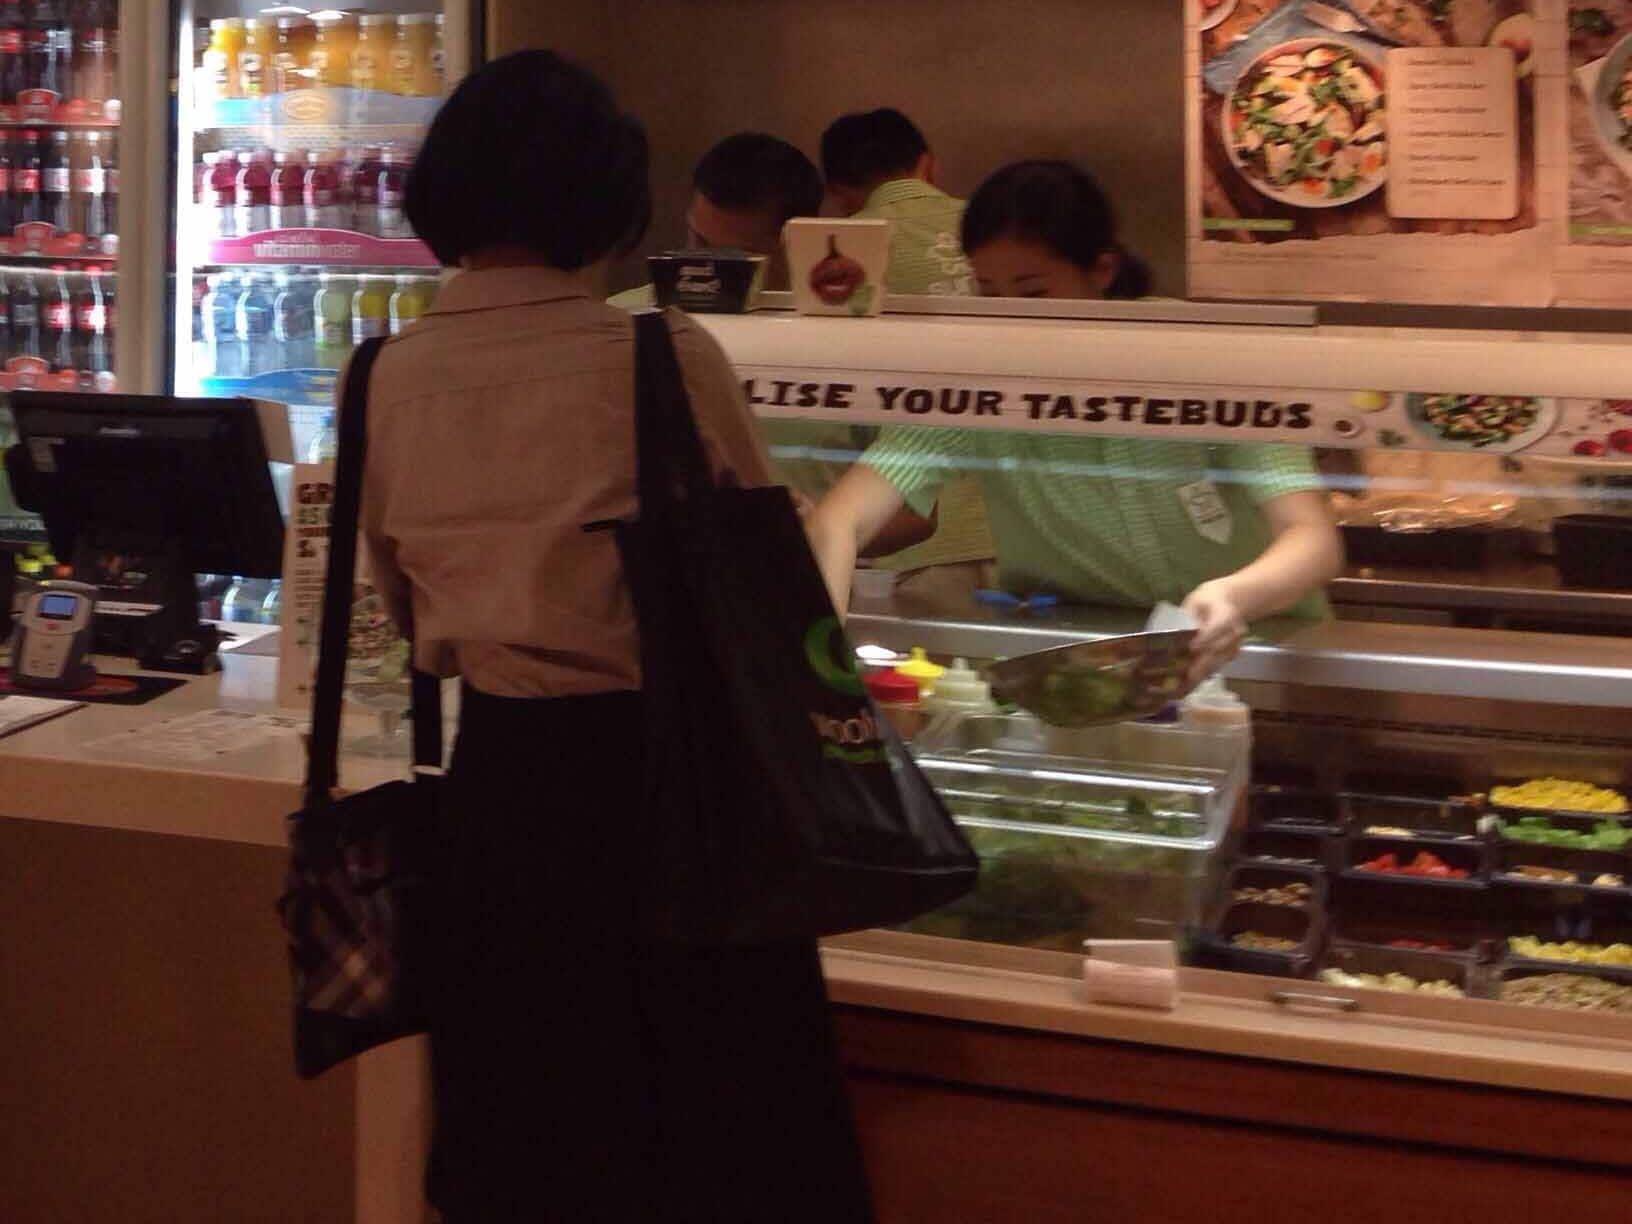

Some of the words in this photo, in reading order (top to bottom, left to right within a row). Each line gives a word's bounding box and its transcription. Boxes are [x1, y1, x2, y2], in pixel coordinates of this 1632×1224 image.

[744, 379, 854, 408] LISE
[876, 386, 1003, 417] YOUR
[1023, 394, 1312, 429] TASTEBUDS
